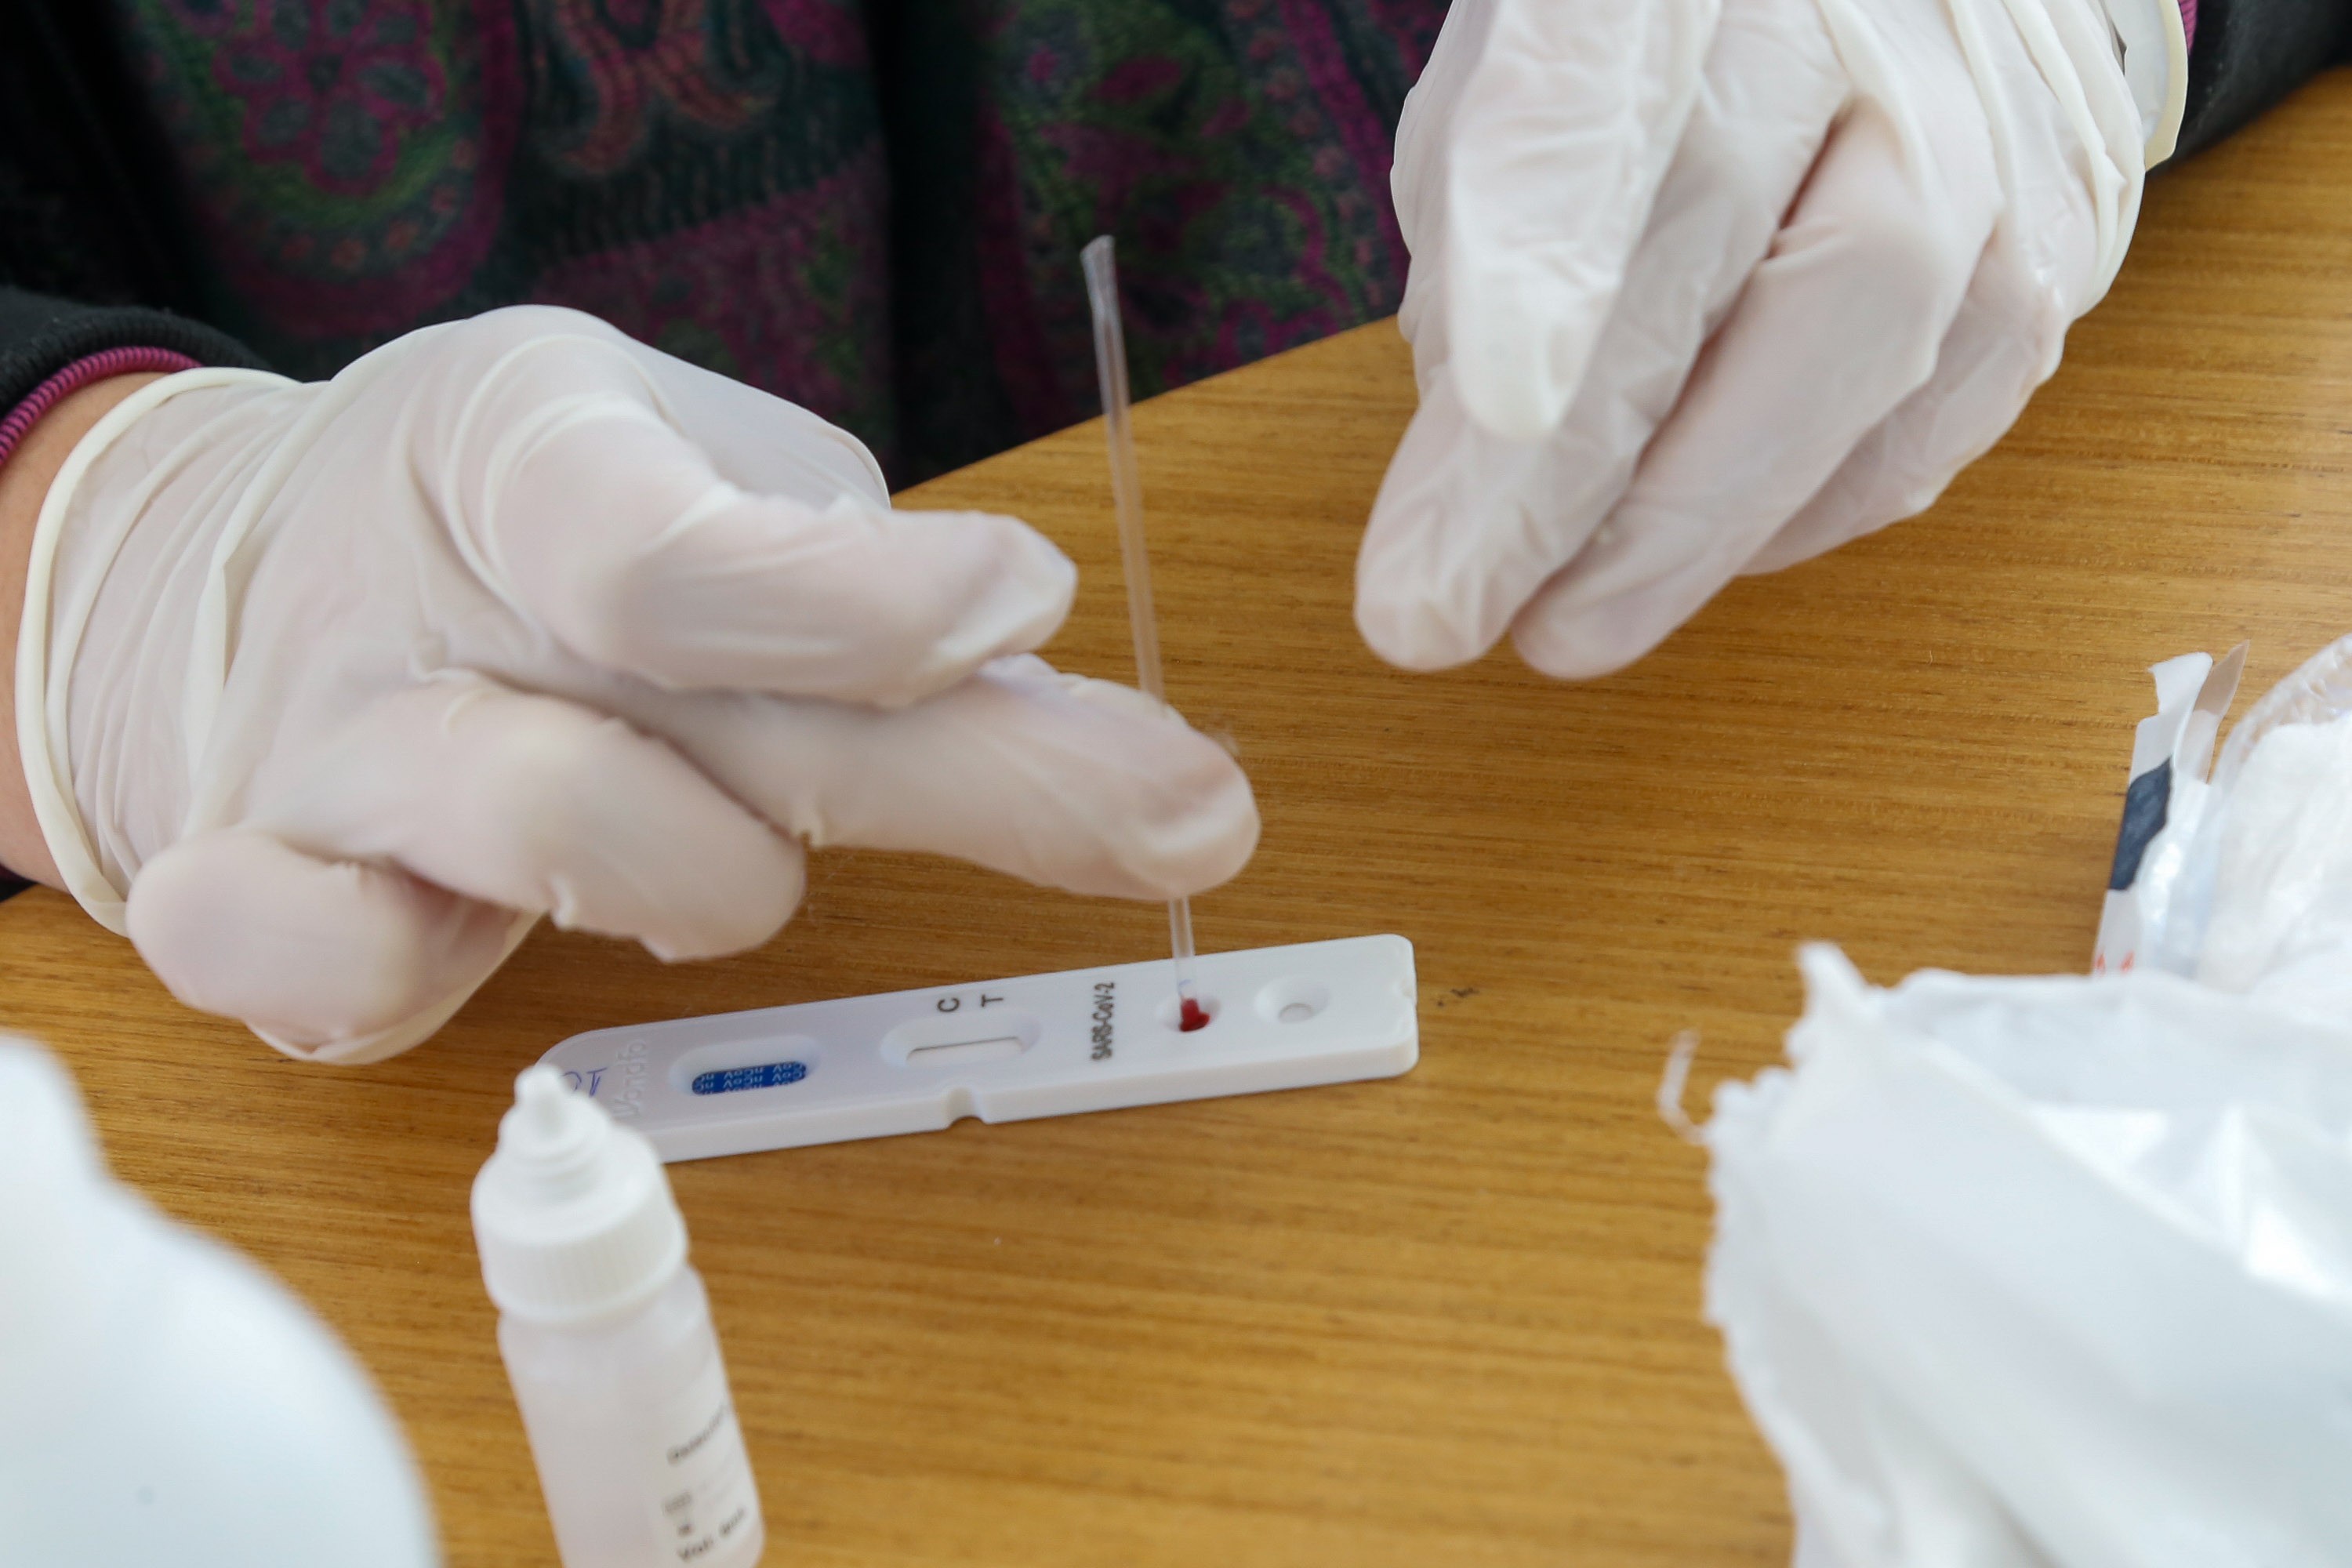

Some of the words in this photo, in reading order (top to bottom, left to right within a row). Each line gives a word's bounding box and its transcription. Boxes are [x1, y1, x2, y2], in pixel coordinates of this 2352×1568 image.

[937, 996, 960, 1013] C
[982, 993, 1004, 1007] T
[1091, 982, 1116, 1061] SARS-CoV-2
